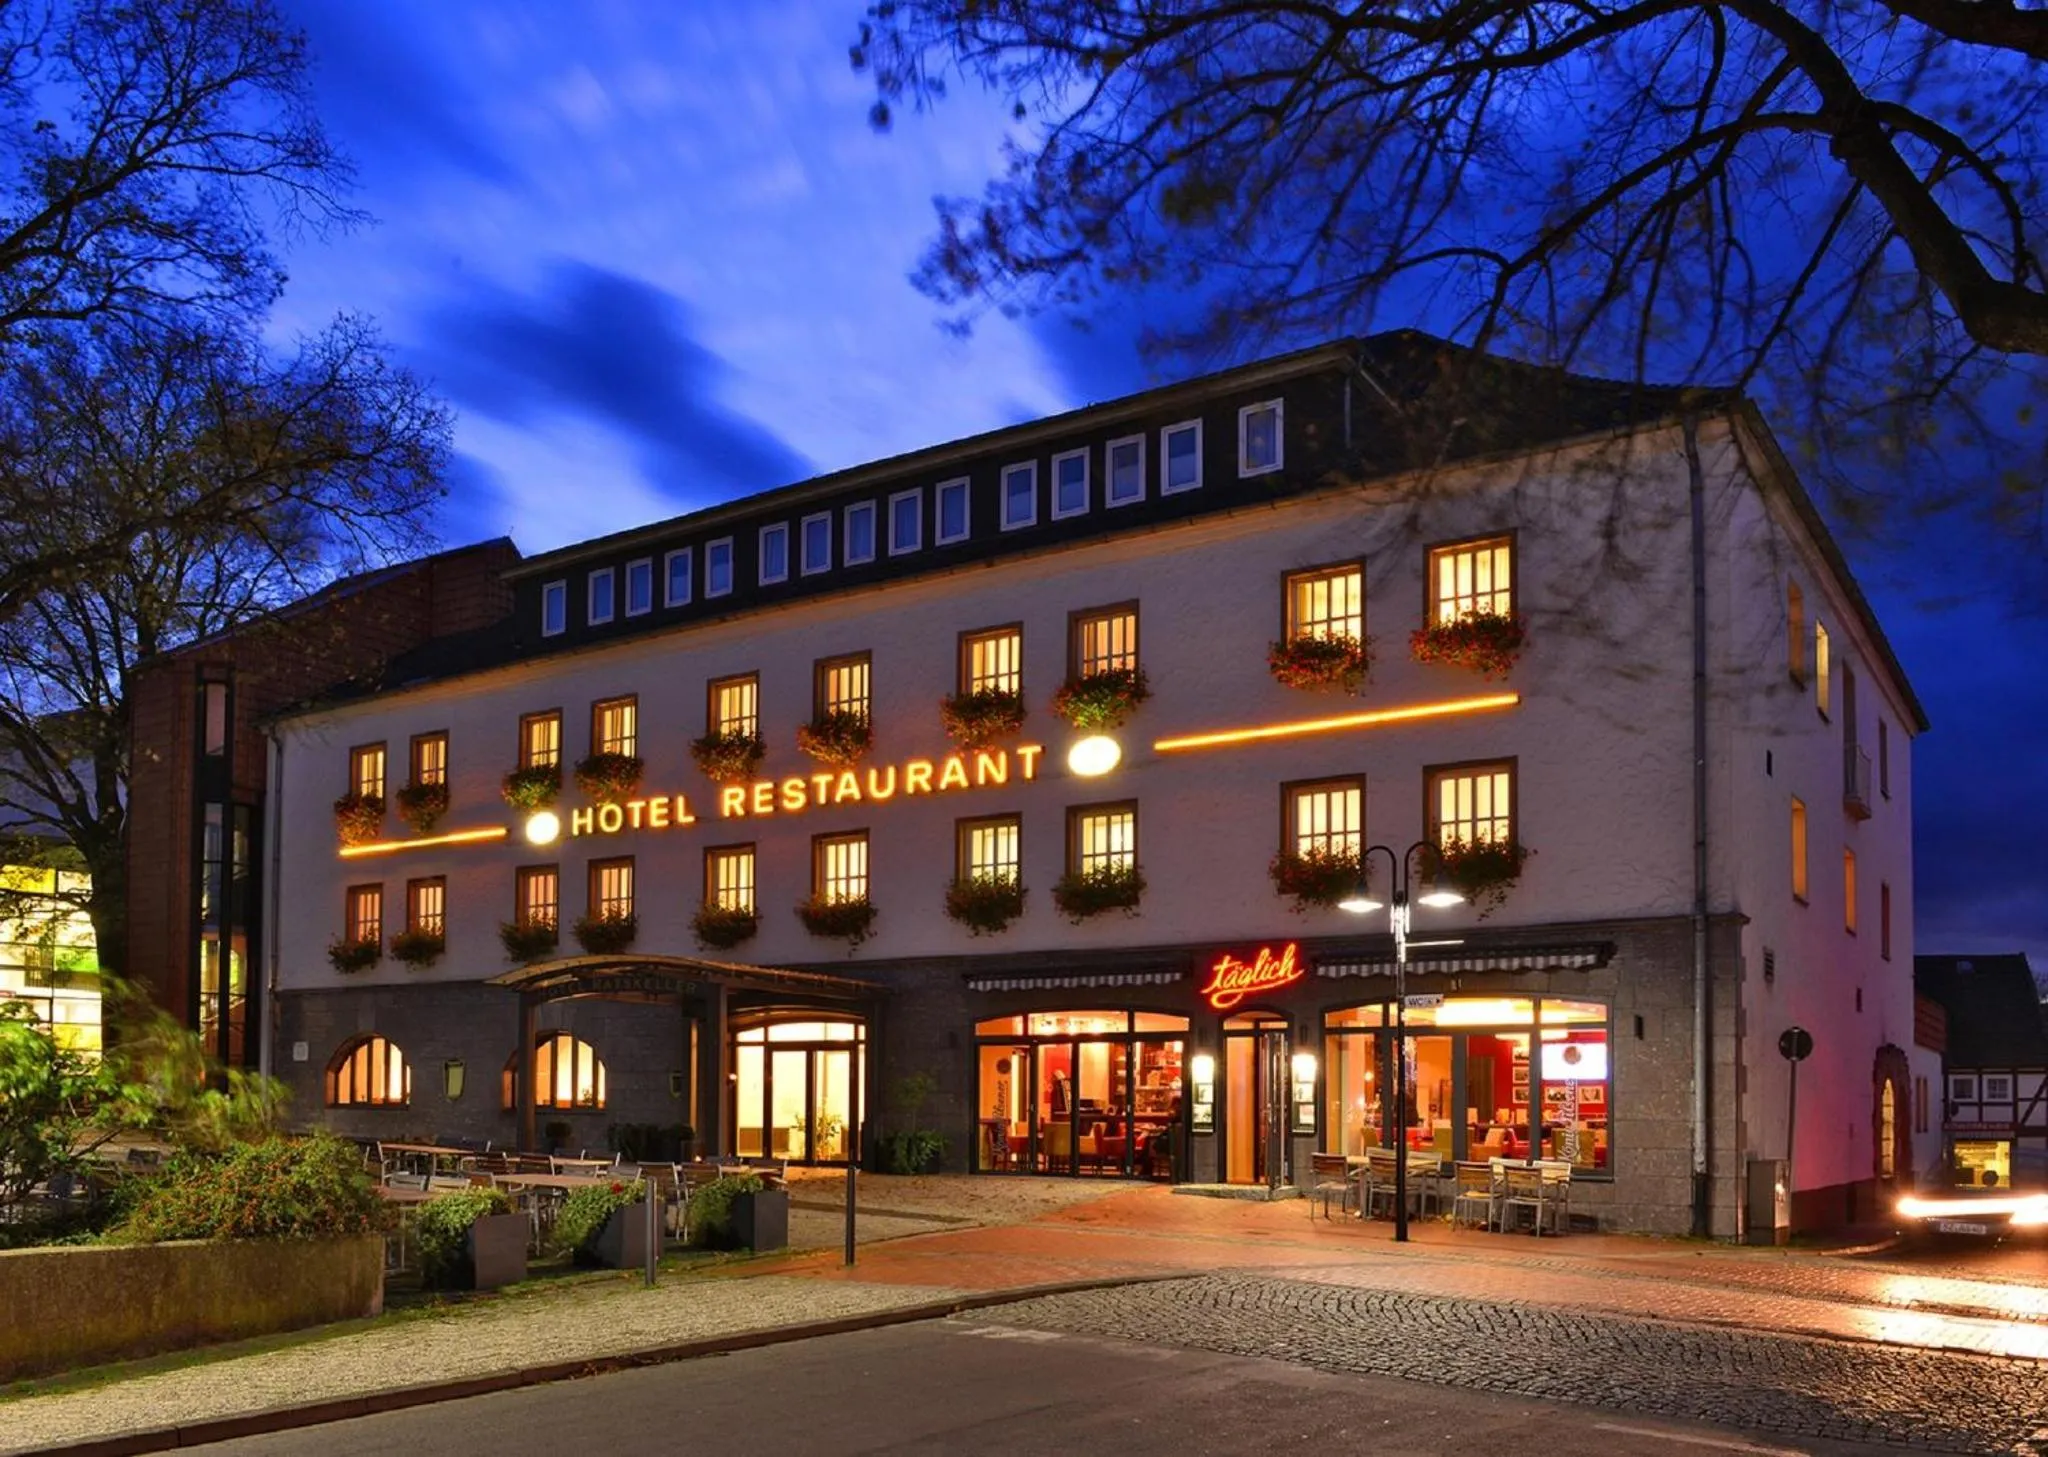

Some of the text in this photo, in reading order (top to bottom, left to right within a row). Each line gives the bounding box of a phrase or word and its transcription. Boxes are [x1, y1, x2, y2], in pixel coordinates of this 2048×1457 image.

[572, 745, 1042, 836] HOTEL RESTAURANT
[1200, 942, 1304, 1008] täglich
[1407, 997, 1424, 1006] WC
[1558, 1074, 1576, 1125] Pilsene
